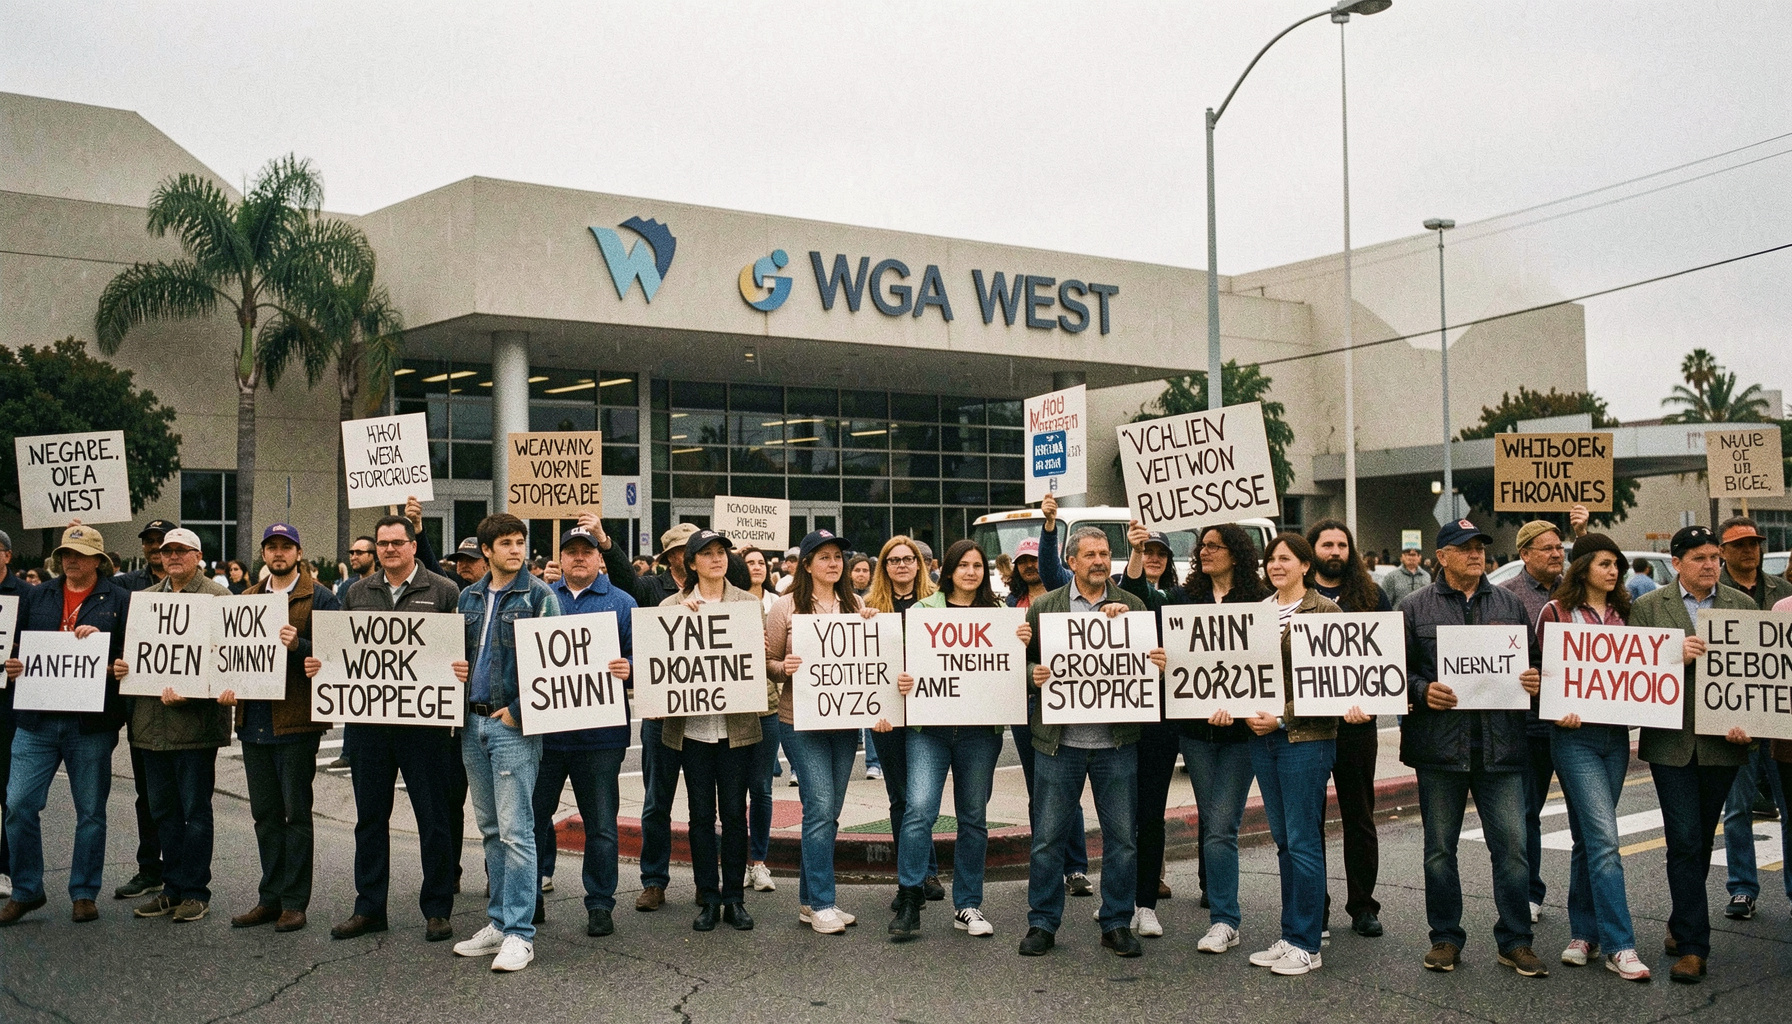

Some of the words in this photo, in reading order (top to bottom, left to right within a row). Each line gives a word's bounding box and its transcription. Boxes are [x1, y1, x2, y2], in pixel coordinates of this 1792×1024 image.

[809, 251, 954, 322] WGA
[972, 269, 1119, 336] WEST
[48, 488, 105, 513] WEST
[222, 605, 268, 638] WOK
[349, 615, 426, 646] WODK
[923, 621, 994, 649] YOUK
[1708, 620, 1740, 645] LE
[136, 642, 202, 676] ROEN
[341, 649, 418, 682] WORK
[316, 683, 456, 720] STOPPEGE
[914, 677, 961, 698] AME
